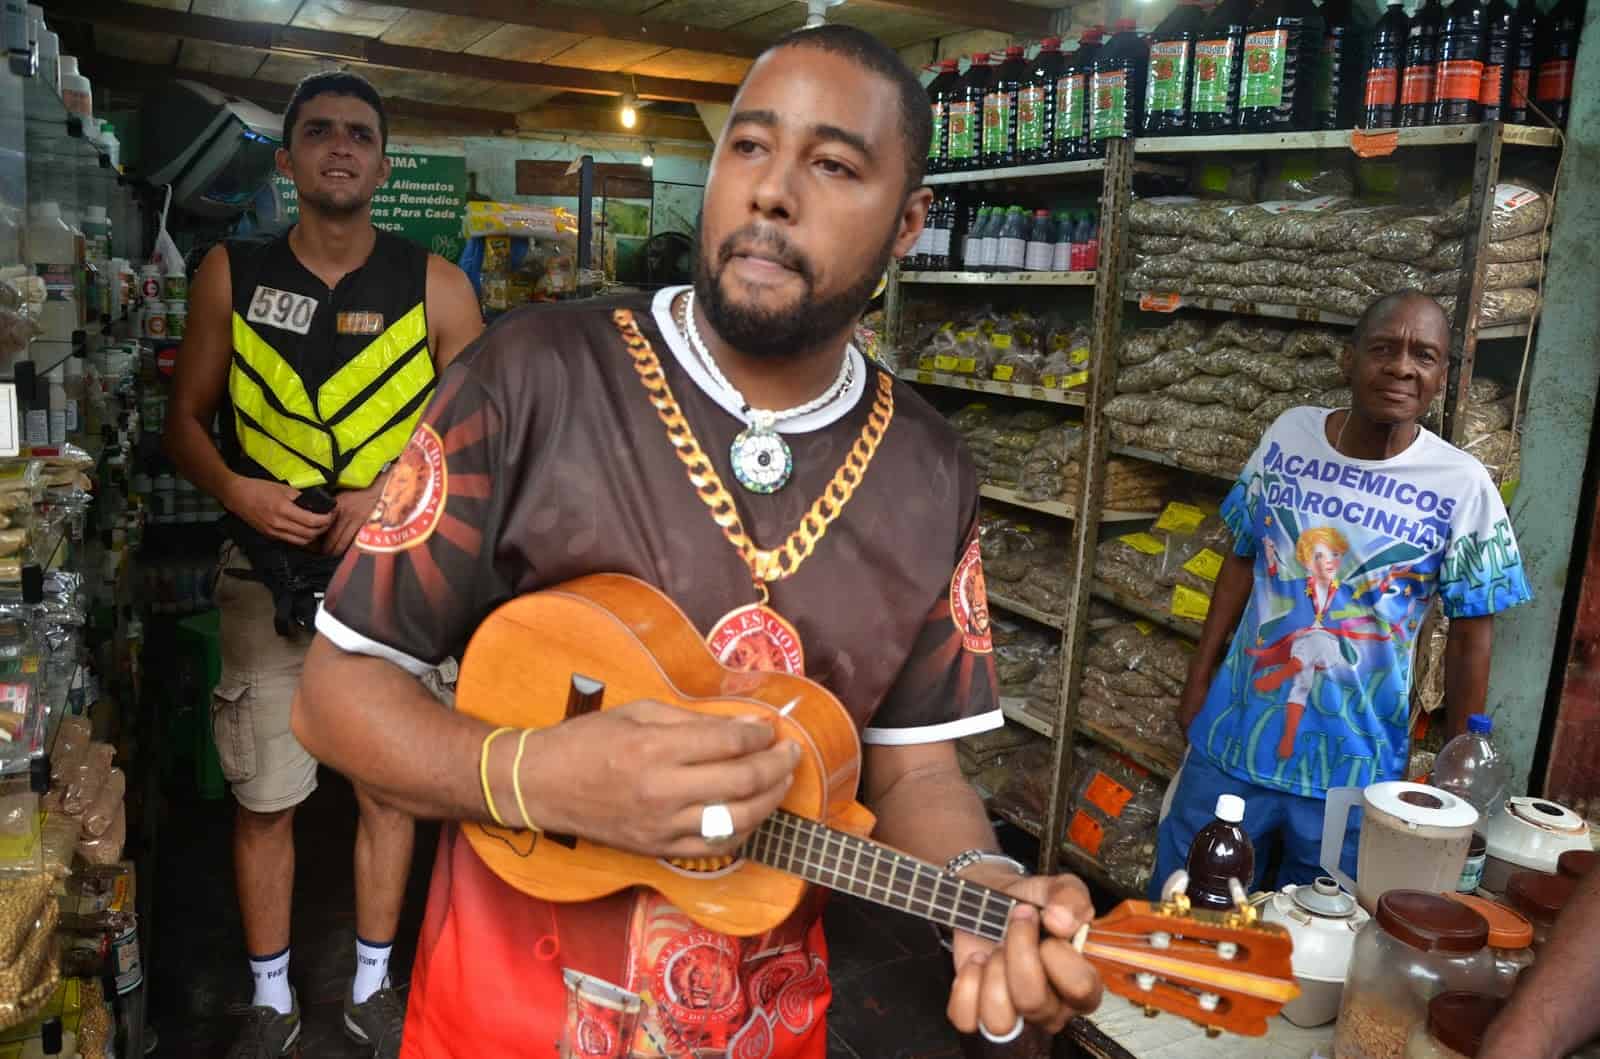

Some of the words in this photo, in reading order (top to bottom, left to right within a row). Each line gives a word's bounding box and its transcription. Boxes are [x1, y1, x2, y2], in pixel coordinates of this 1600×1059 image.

[392, 179, 454, 192] Alimentos
[399, 193, 460, 206] Remédios
[393, 207, 421, 218] Para
[425, 208, 455, 218] Cada
[253, 288, 311, 328] 590
[1267, 483, 1294, 508] DA
[1300, 490, 1437, 552] ROCINHA
